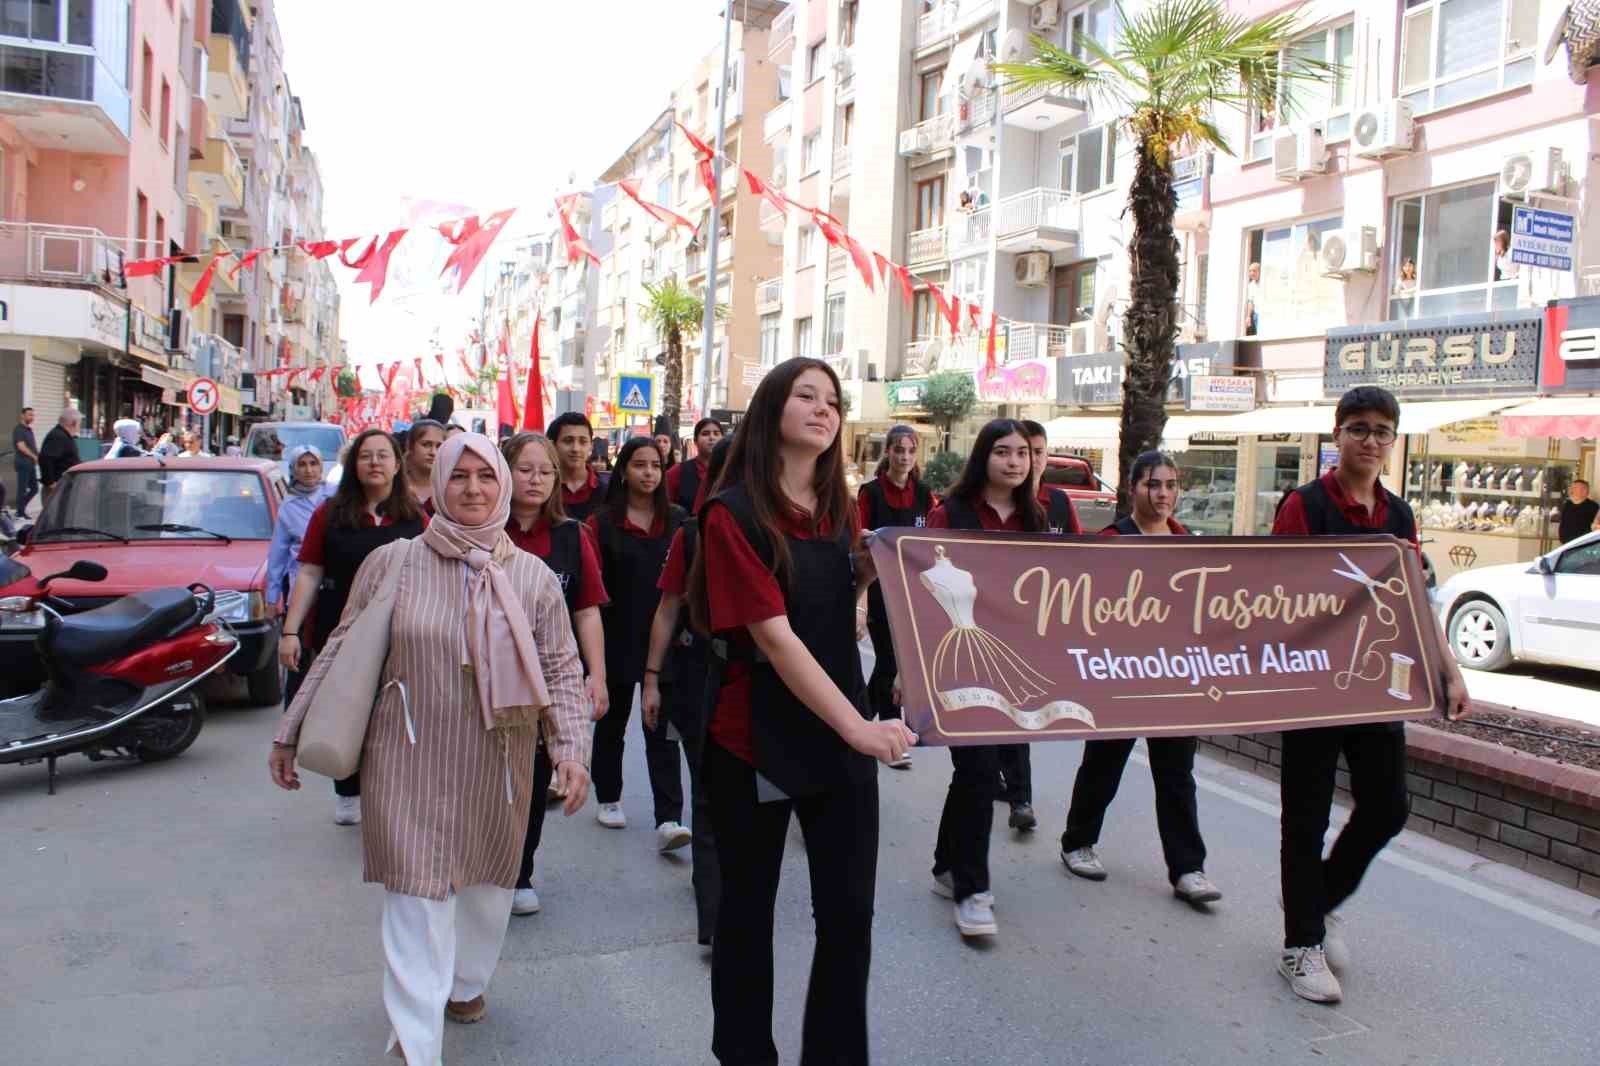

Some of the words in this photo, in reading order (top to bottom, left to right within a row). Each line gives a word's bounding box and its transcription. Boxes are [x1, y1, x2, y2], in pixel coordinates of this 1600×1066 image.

[1339, 331, 1517, 370] GÜRSU
[1013, 566, 1171, 636] Moda
[1169, 564, 1346, 634] Tasarım
[1067, 645, 1251, 685] Teknolojileri
[1260, 643, 1331, 674] Alanı
